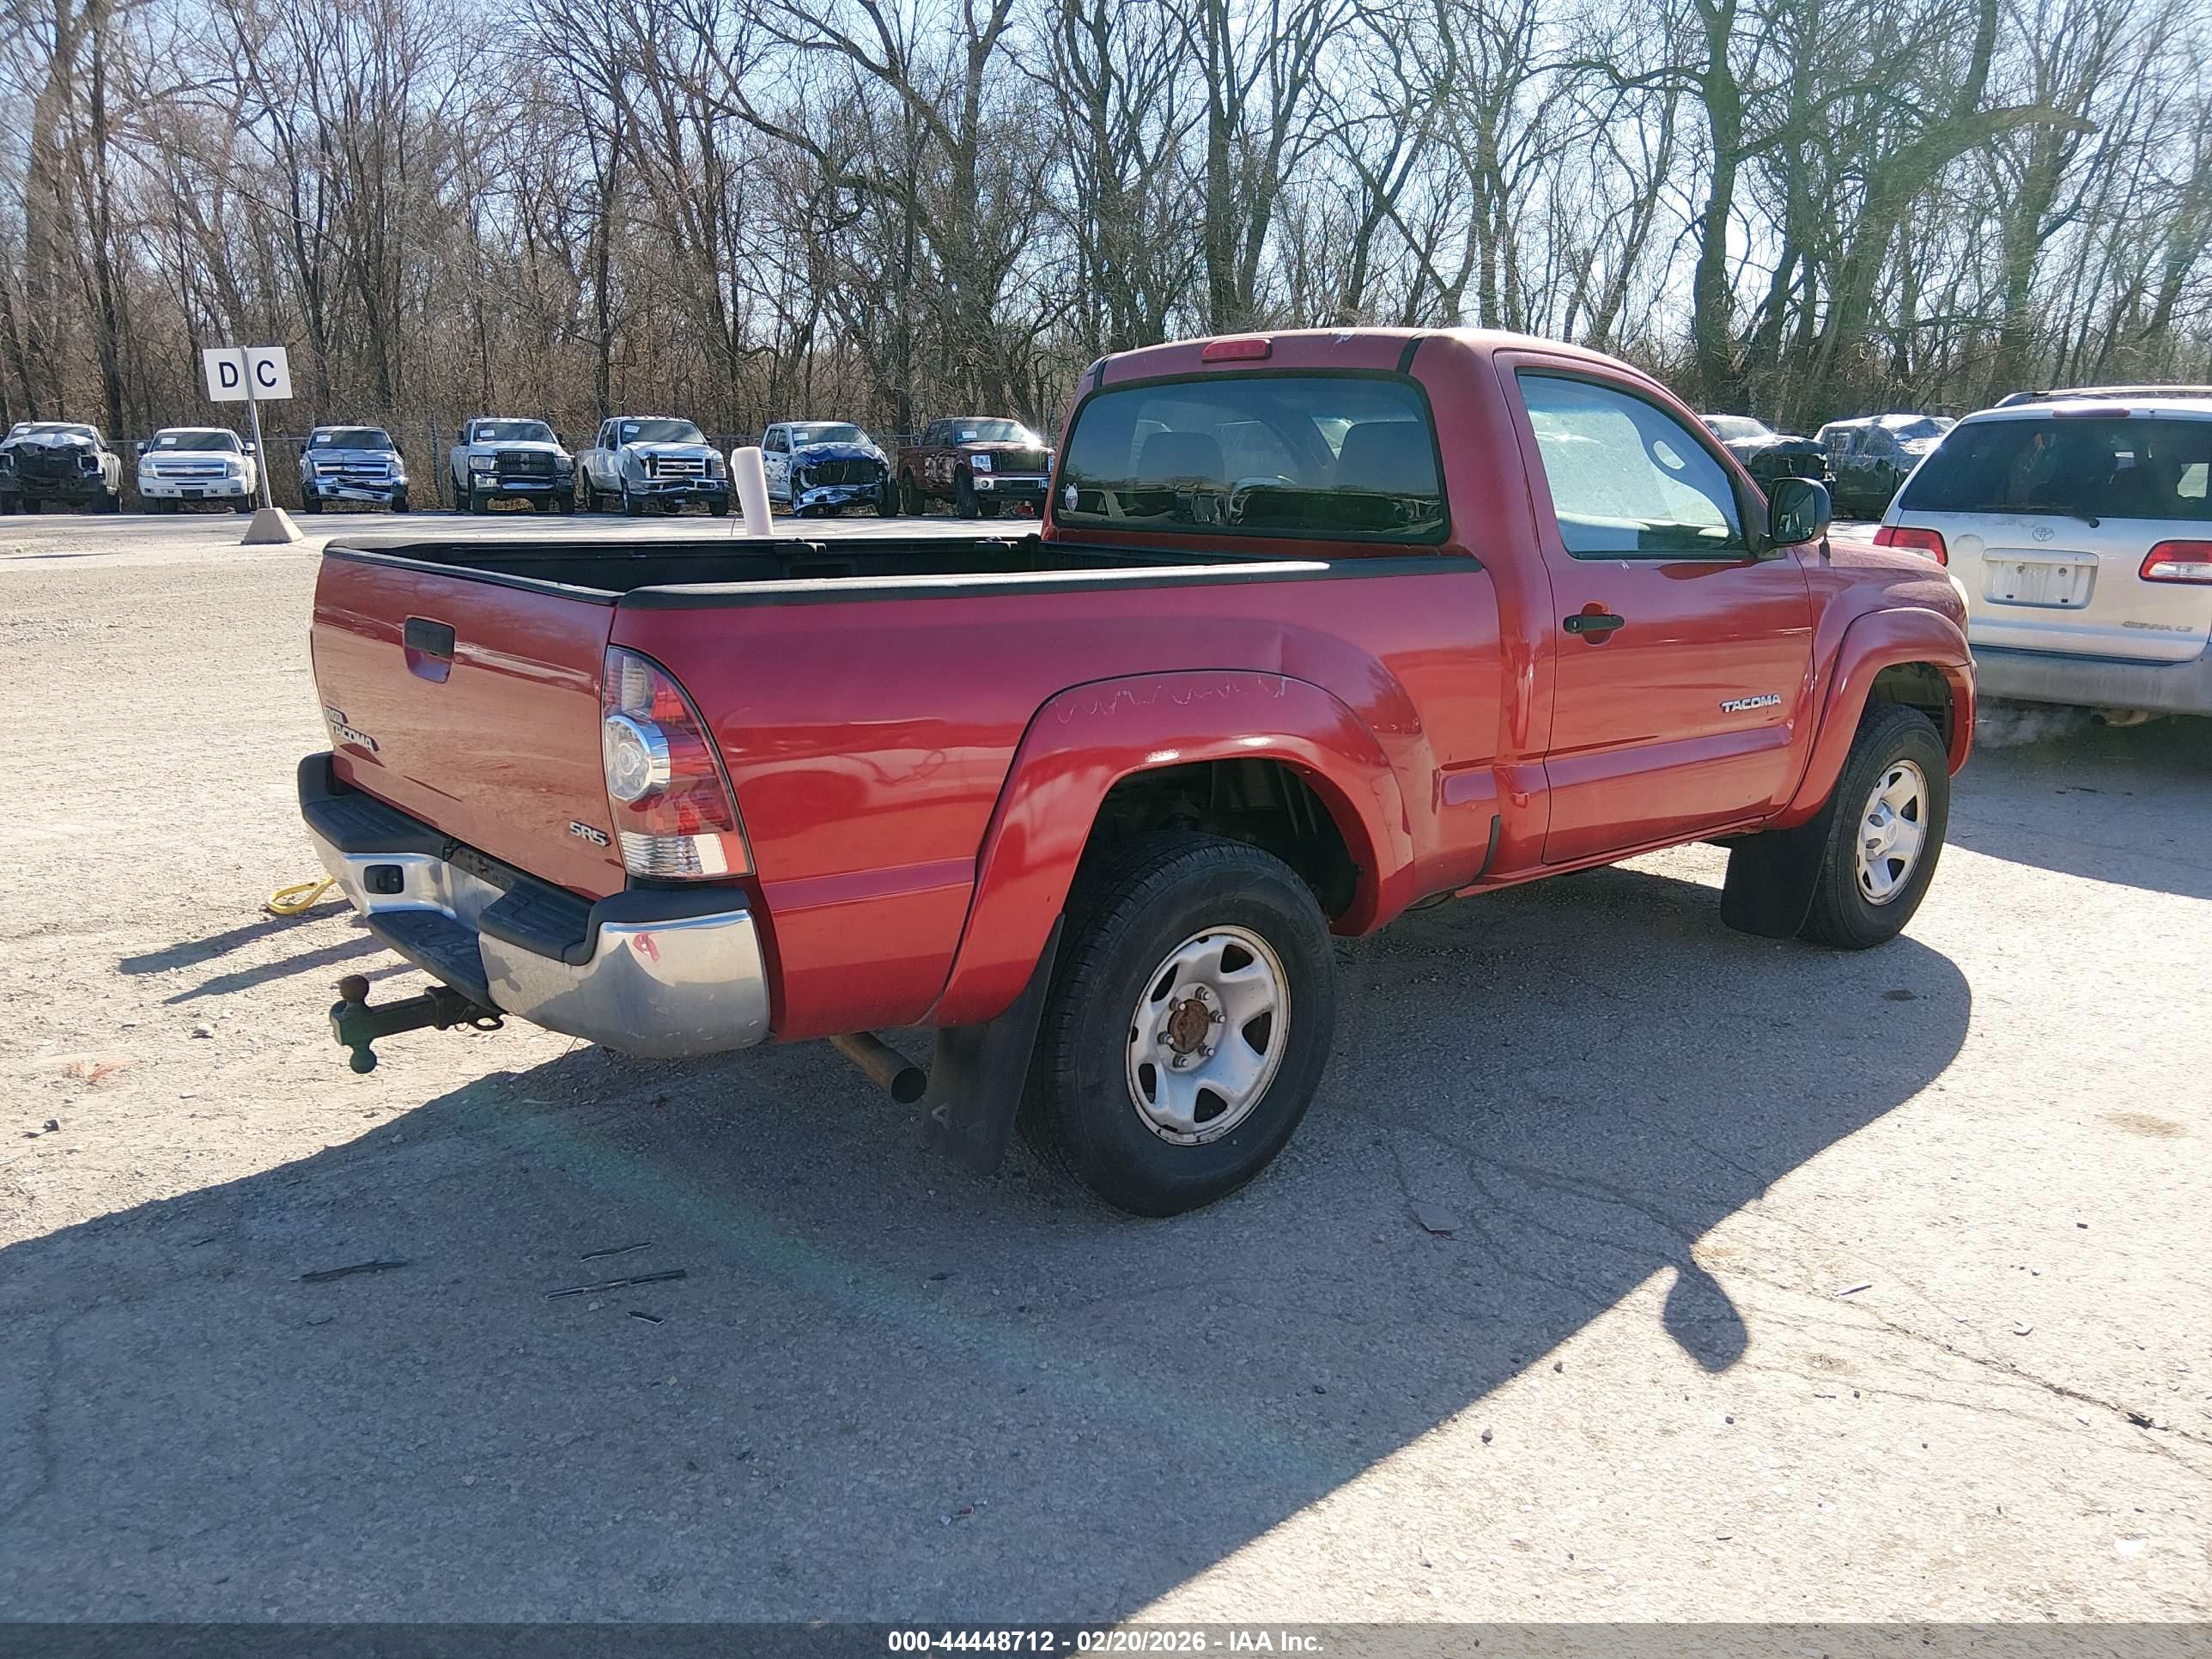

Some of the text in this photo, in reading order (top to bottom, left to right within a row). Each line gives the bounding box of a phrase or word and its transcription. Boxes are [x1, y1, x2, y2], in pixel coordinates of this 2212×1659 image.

[218, 362, 239, 388] D
[256, 360, 277, 387] C
[1720, 693, 1782, 714] TACOMA
[329, 720, 376, 753] TACOMA
